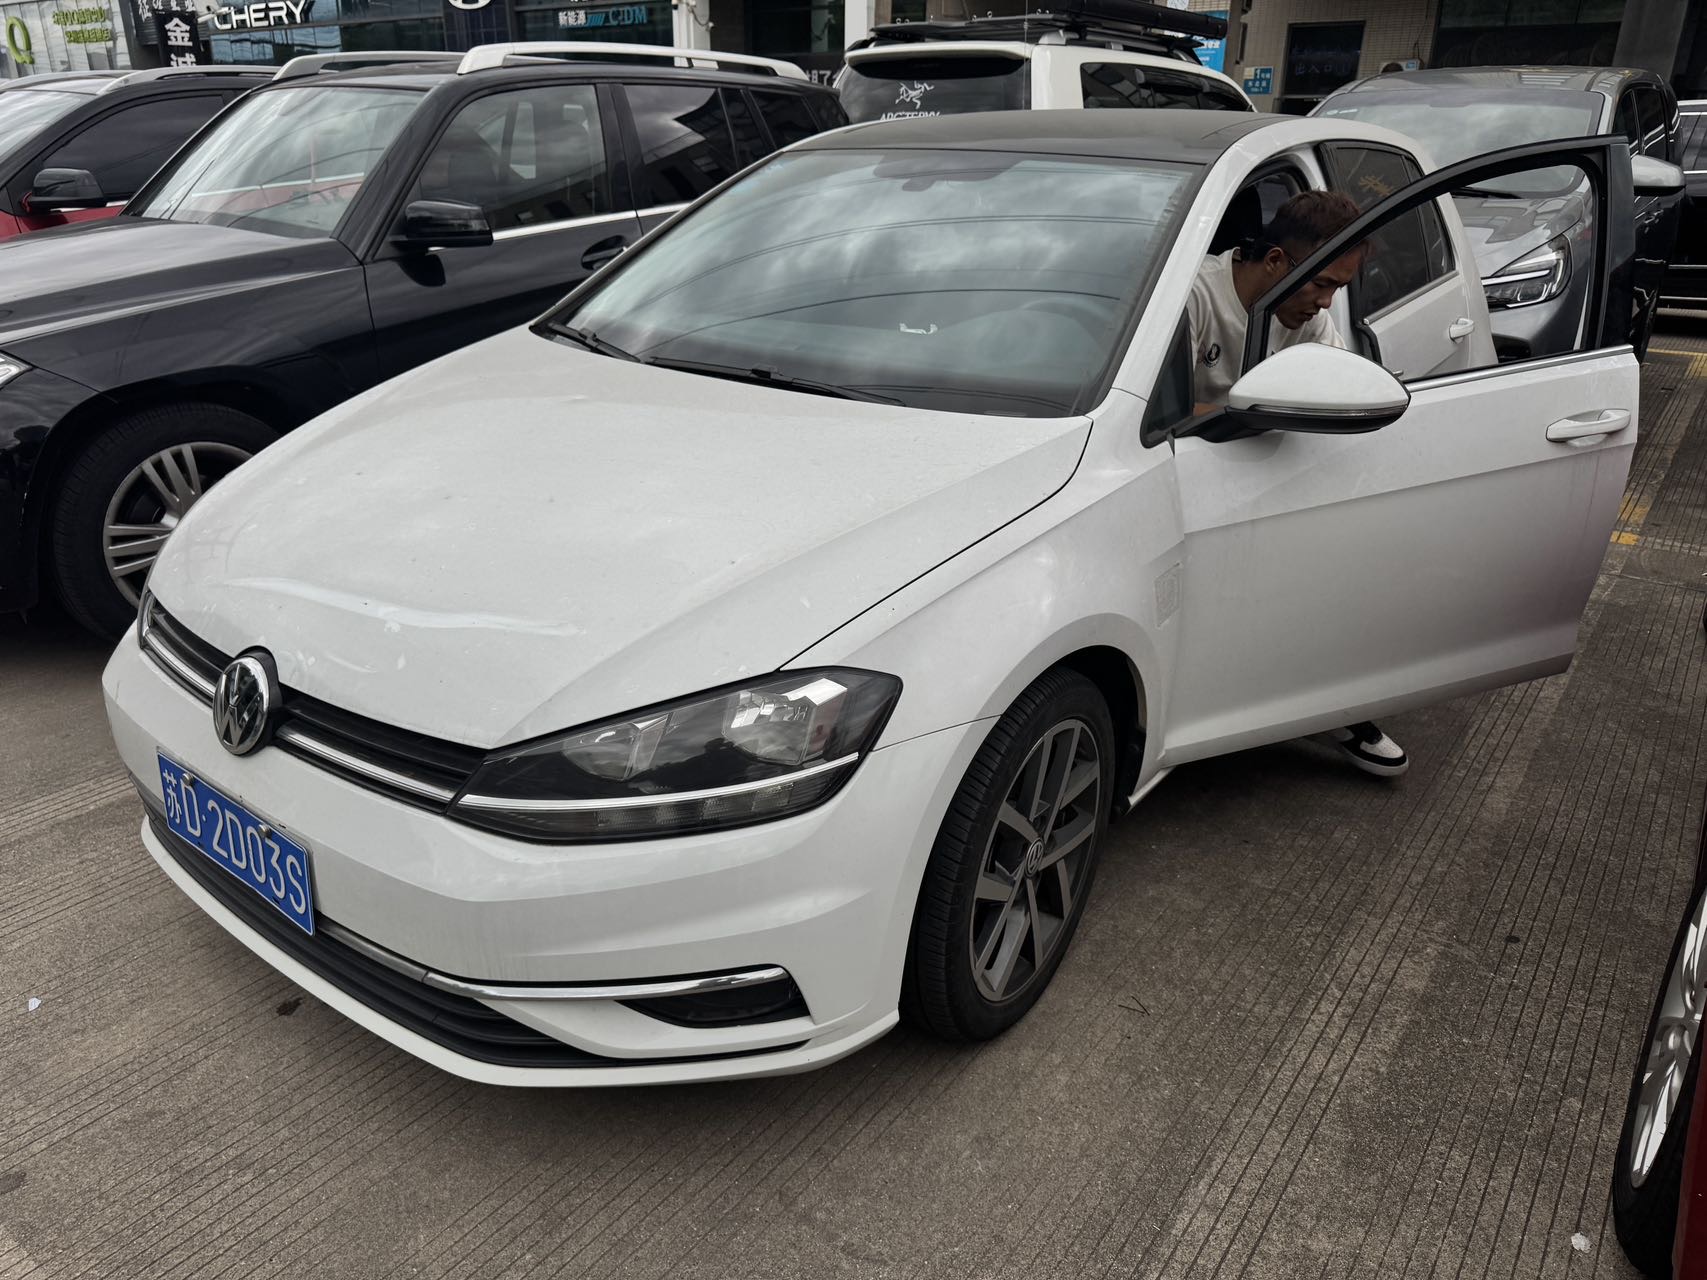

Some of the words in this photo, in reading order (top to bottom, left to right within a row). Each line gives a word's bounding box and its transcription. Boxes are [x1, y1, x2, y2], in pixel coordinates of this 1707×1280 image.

[214, 0, 305, 30] CHERY
[558, 10, 586, 26] 新能源
